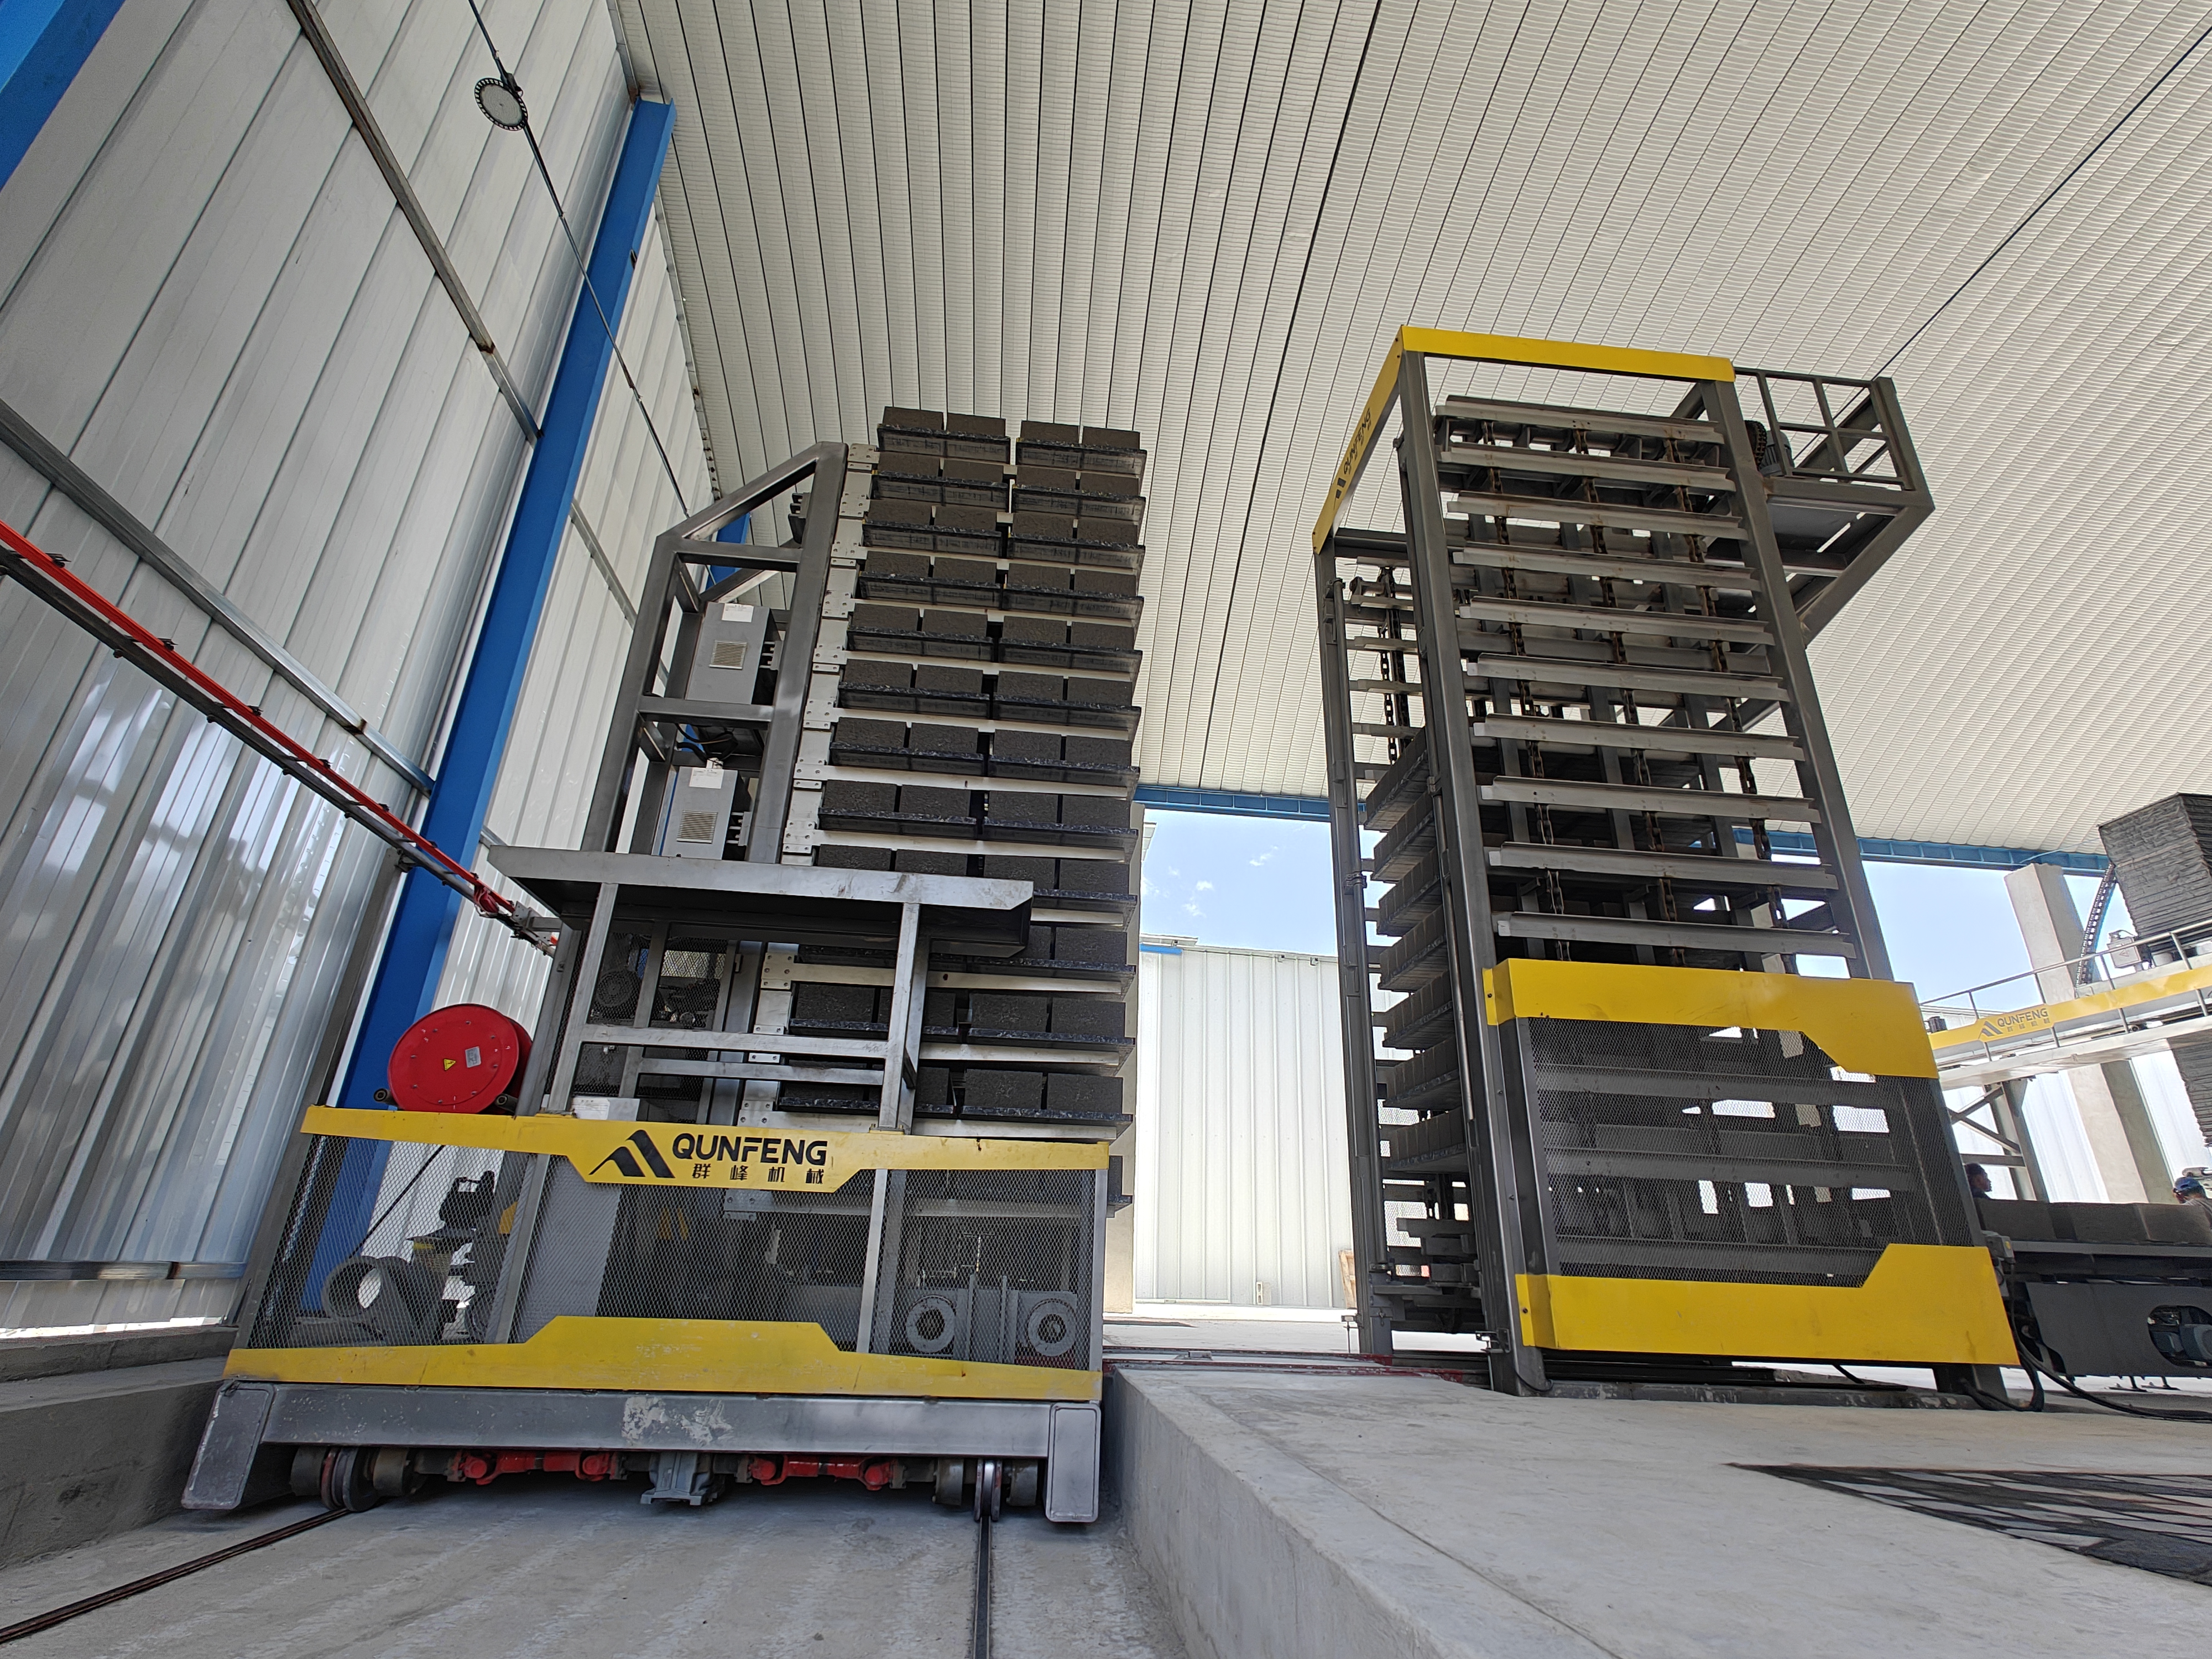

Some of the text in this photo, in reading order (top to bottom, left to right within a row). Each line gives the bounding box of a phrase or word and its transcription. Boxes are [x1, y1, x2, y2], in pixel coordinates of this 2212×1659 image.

[1997, 1008, 2048, 1027] QUNFENG
[672, 1133, 828, 1166] QUNFENG
[692, 1163, 825, 1184] 群峰机械
